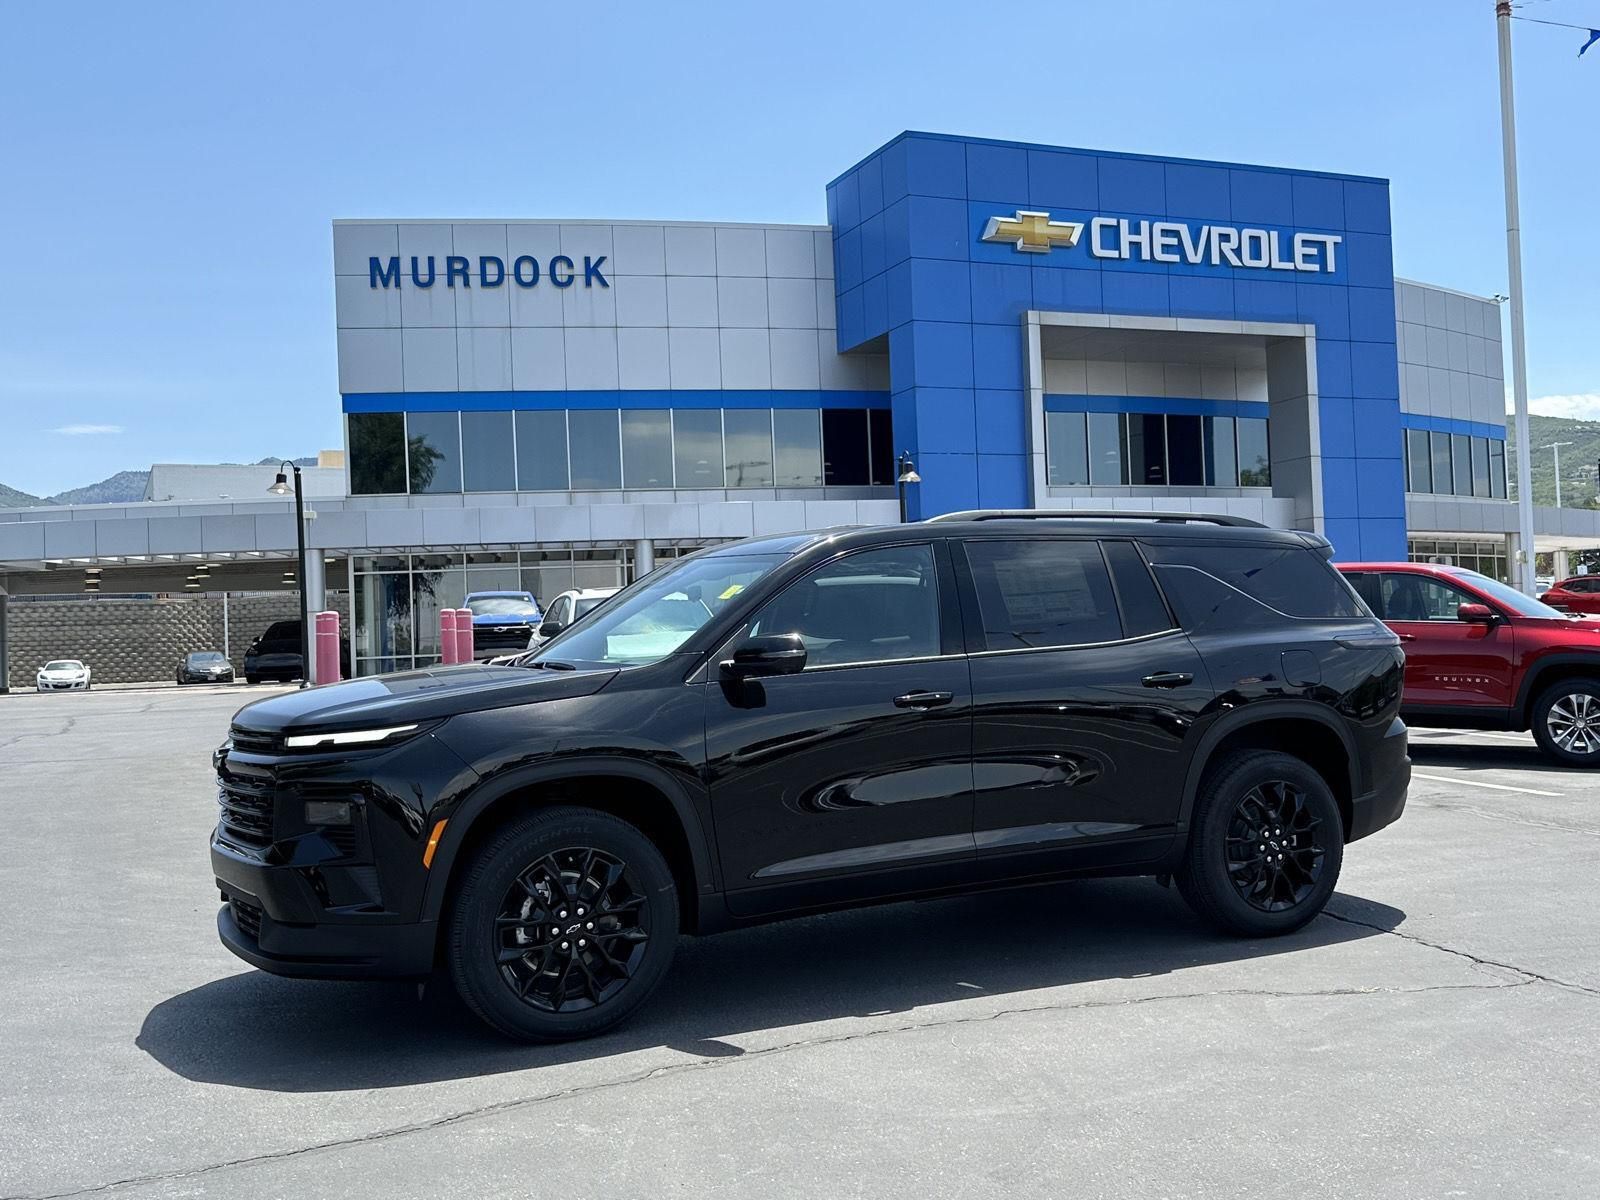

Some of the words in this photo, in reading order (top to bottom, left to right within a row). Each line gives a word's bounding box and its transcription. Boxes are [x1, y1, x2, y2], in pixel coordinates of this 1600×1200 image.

[1091, 217, 1342, 272] CHEVROLET
[369, 255, 610, 289] MURDOCK
[1435, 676, 1489, 684] EQUINOX
